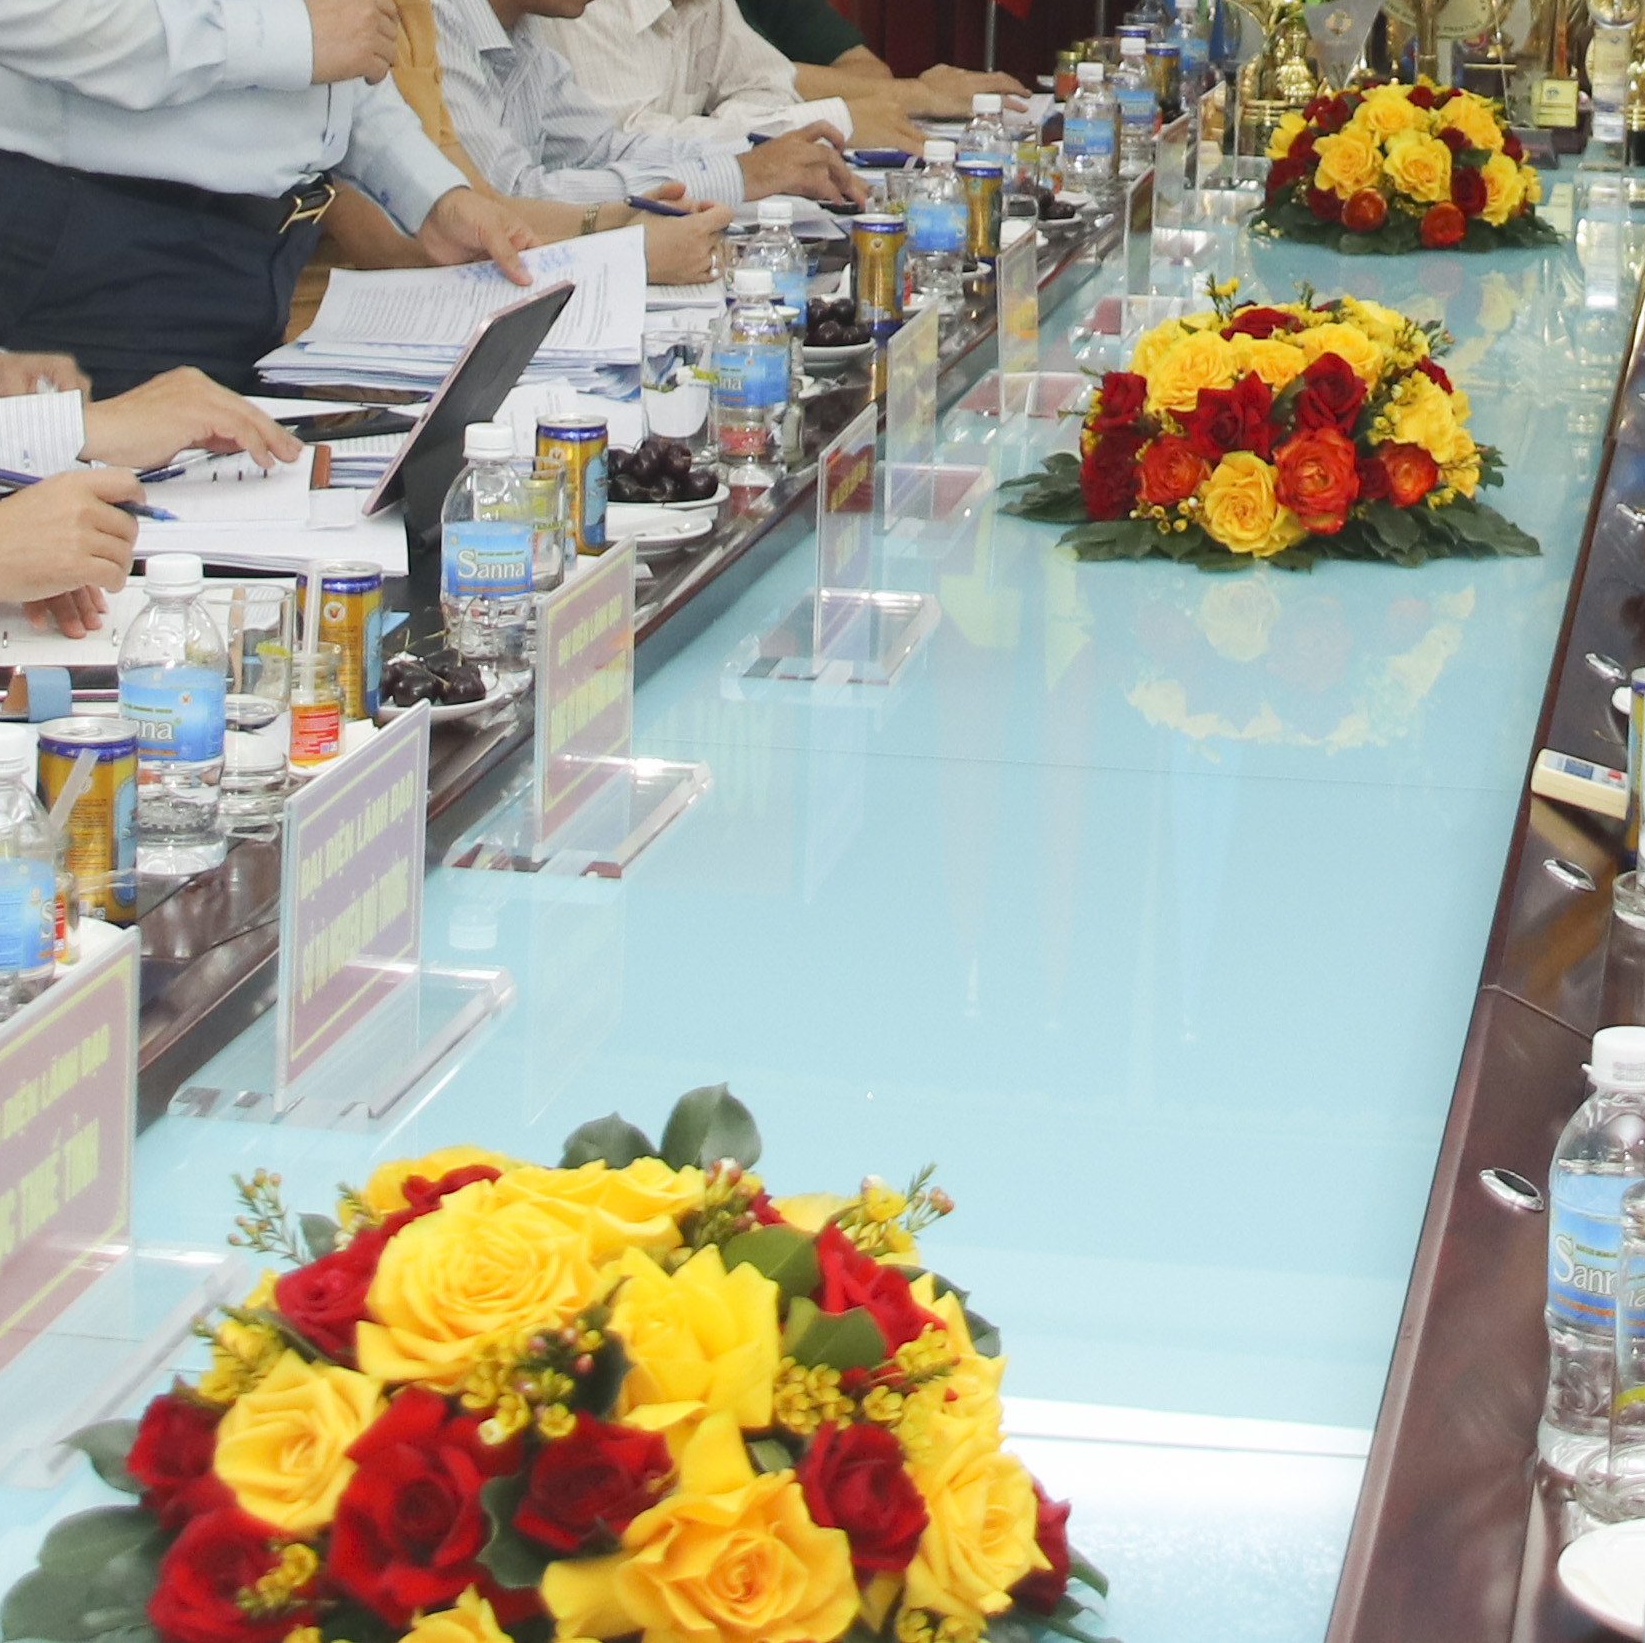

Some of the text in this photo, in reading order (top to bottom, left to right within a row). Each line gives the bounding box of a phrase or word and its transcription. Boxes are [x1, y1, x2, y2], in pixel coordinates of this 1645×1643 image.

[458, 549, 525, 579] Sanna
[300, 769, 415, 902] ĐẠI DIỆN LÃNH ĐẠO
[2, 1077, 39, 1140] DIỆN
[40, 1045, 78, 1109] LÃNH
[80, 1022, 111, 1078] ĐẠO
